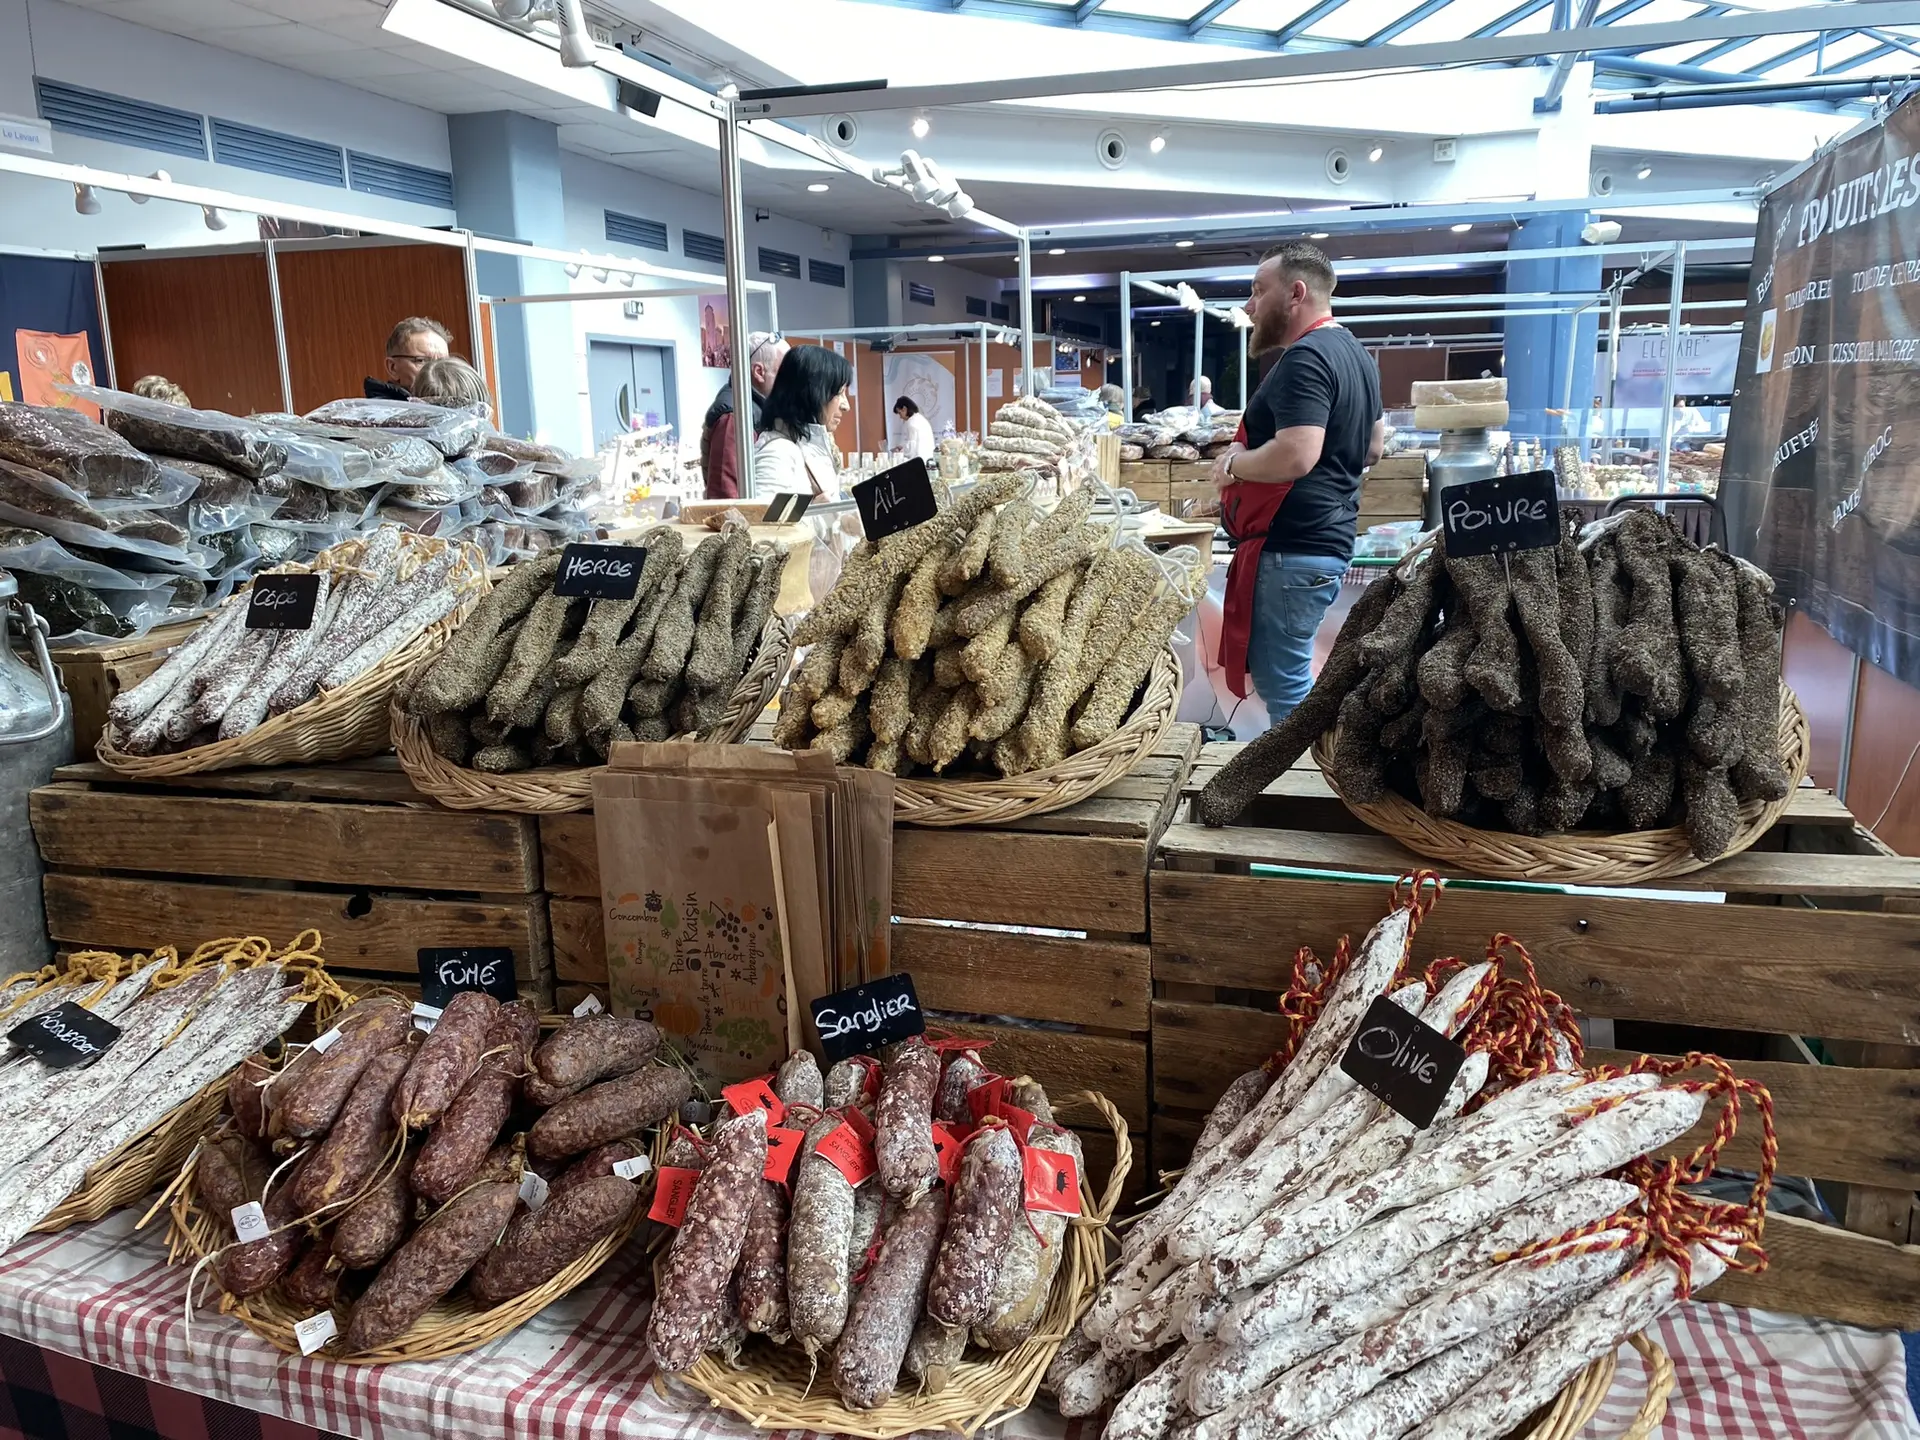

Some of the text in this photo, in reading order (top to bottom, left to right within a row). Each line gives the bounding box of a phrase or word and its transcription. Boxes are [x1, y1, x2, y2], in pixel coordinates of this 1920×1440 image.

[563, 556, 633, 585] HERBE
[608, 907, 660, 924] Concombre
[682, 891, 700, 943] Raisin
[668, 937, 684, 975] Poire
[704, 942, 746, 963] Abricot
[742, 932, 765, 986] Aubergine
[439, 959, 501, 986] FUMÉ
[722, 982, 766, 1014] Fruit
[828, 1140, 861, 1173] SANGLIER
